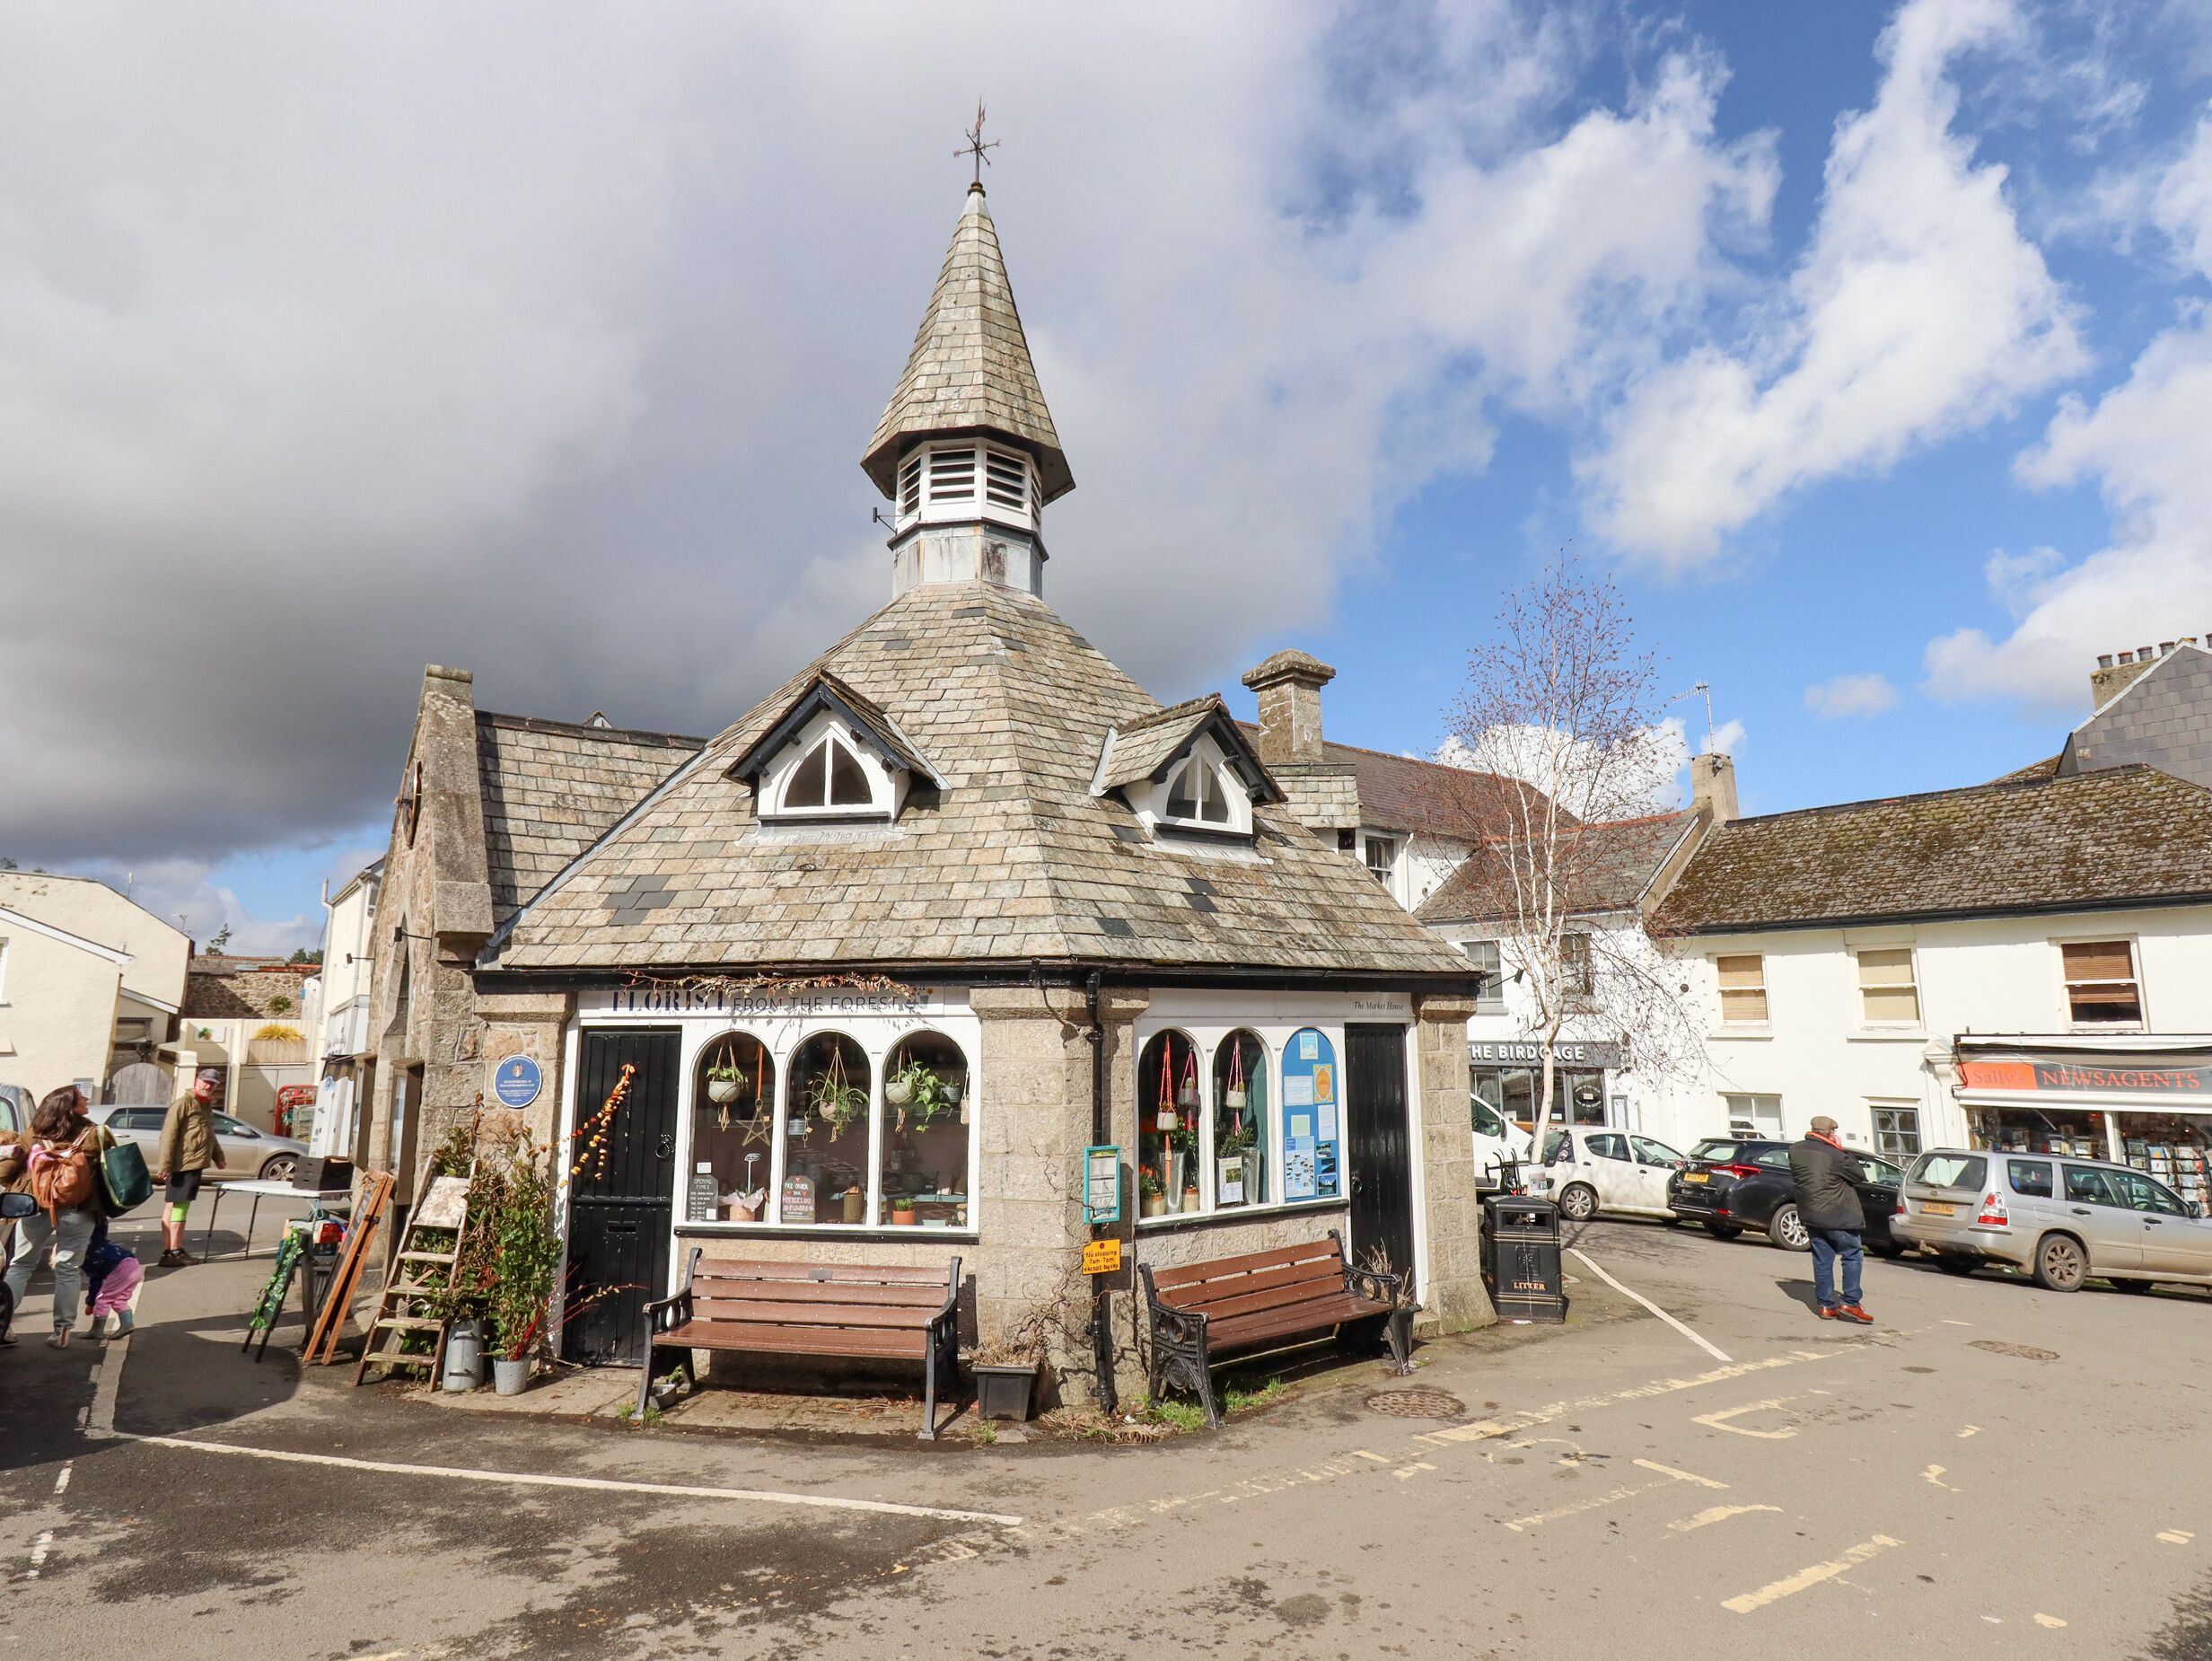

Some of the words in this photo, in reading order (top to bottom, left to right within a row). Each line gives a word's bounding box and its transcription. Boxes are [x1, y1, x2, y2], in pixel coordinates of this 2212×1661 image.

[733, 997, 783, 1011] FROM
[789, 997, 824, 1011] THE
[830, 997, 899, 1011] FOREST
[1354, 1001, 1365, 1009] The
[1366, 1001, 1386, 1009] Market
[1387, 1001, 1404, 1010] House
[1973, 1069, 2025, 1085] Sally's
[2041, 1070, 2200, 1088] NEWSAGENTS
[1513, 1281, 1546, 1291] LITTER
